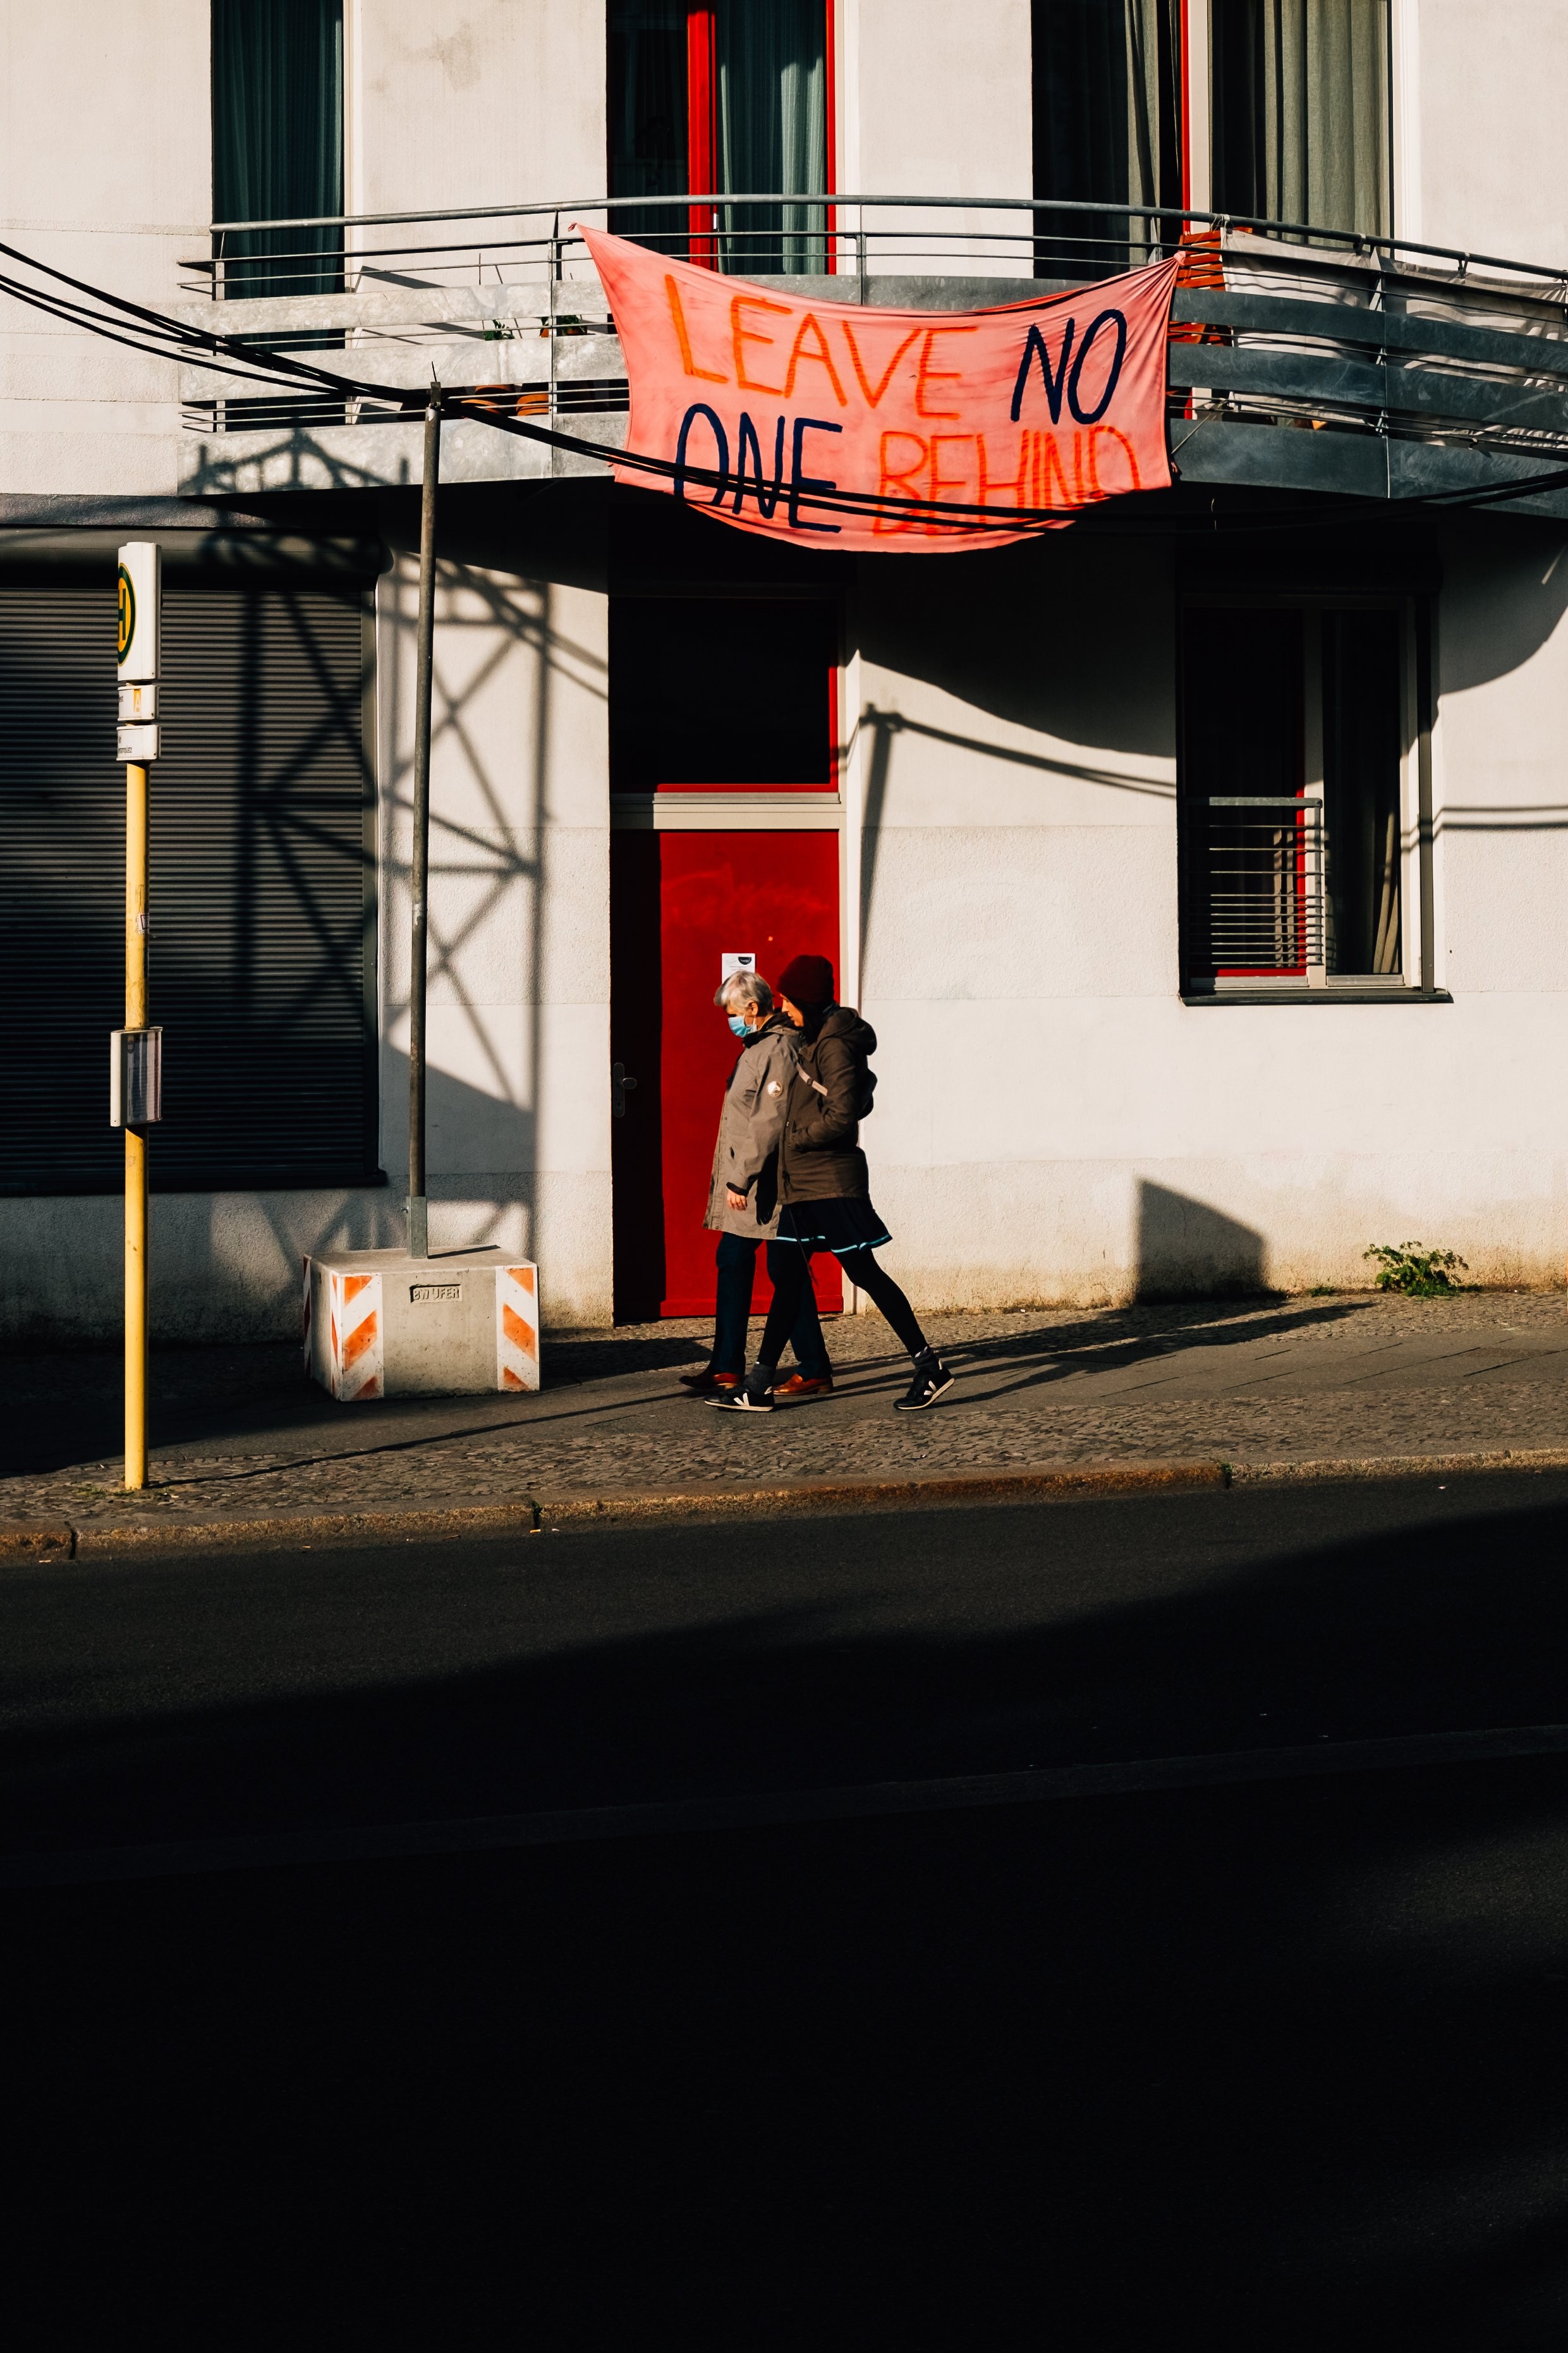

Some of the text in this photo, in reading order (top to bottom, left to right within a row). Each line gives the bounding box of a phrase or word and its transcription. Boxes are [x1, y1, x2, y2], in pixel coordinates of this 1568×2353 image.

[664, 274, 1127, 425] LEAVE NO
[673, 403, 1141, 539] ONE BEHIND
